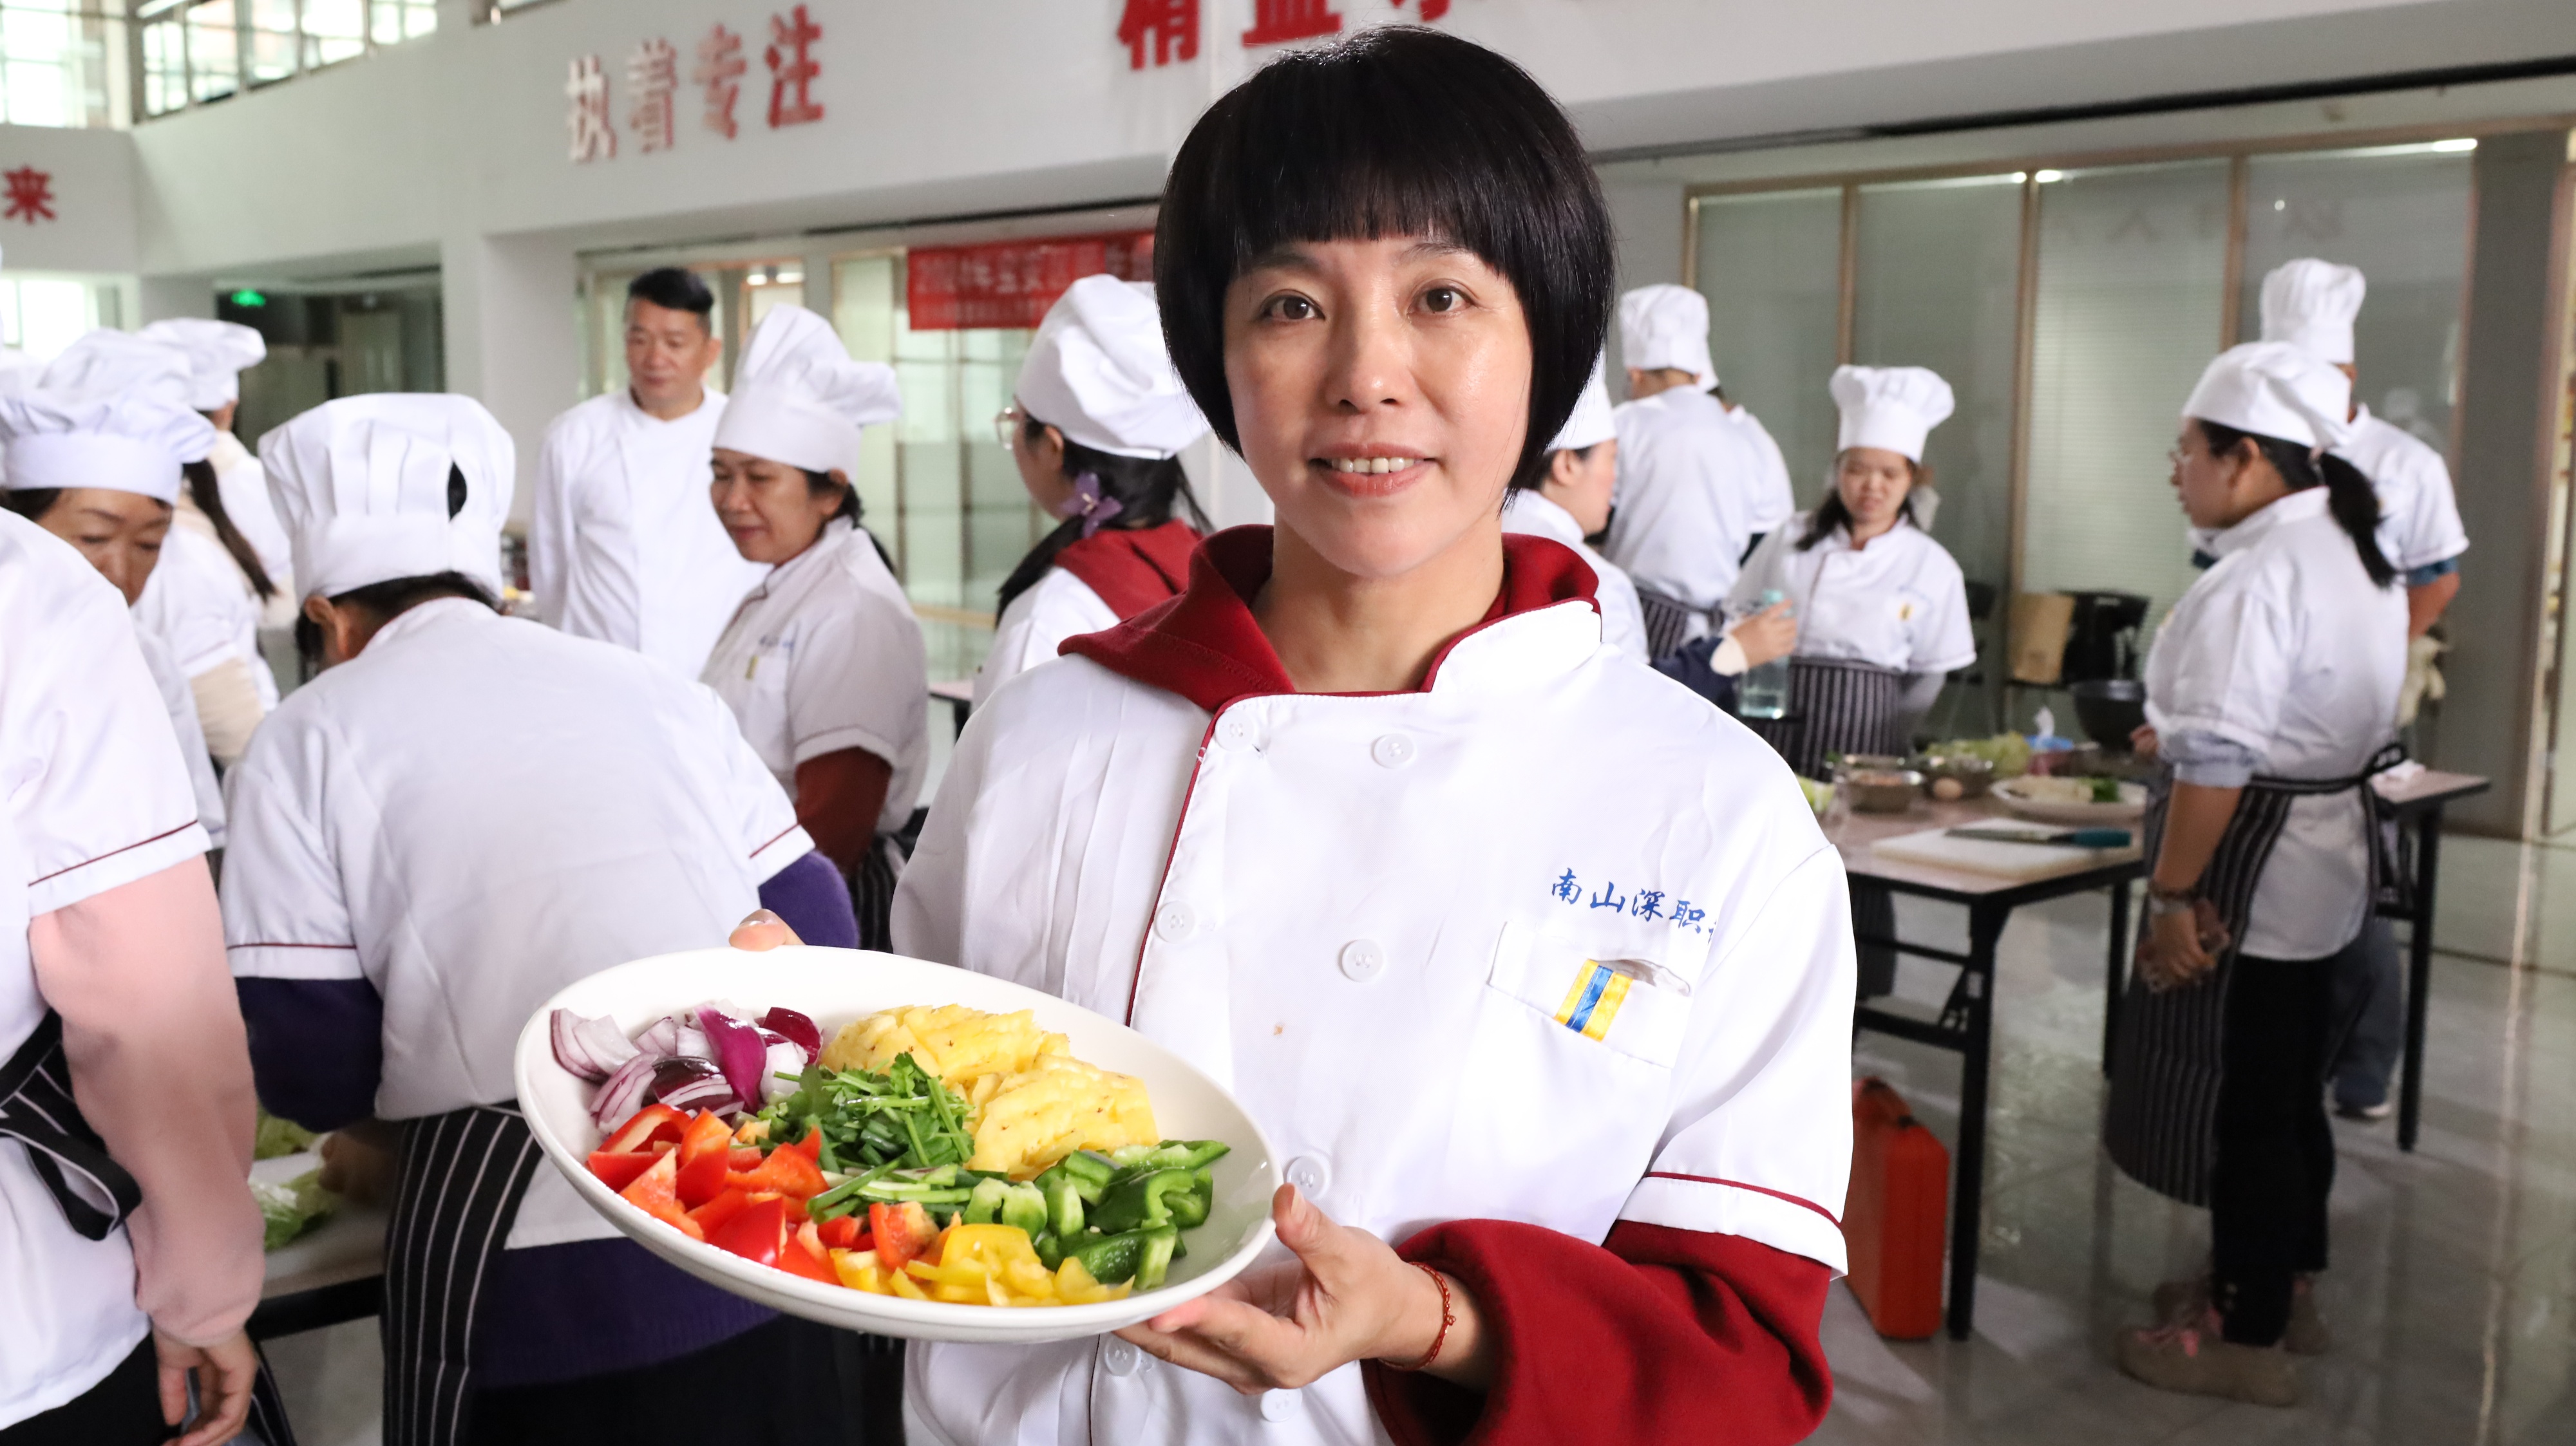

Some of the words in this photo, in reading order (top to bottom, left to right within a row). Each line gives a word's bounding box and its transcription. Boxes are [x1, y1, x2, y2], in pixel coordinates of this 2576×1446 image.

[564, 3, 825, 164] 执着专注
[2, 164, 57, 225] 来
[1551, 867, 1718, 945] 南山深职
